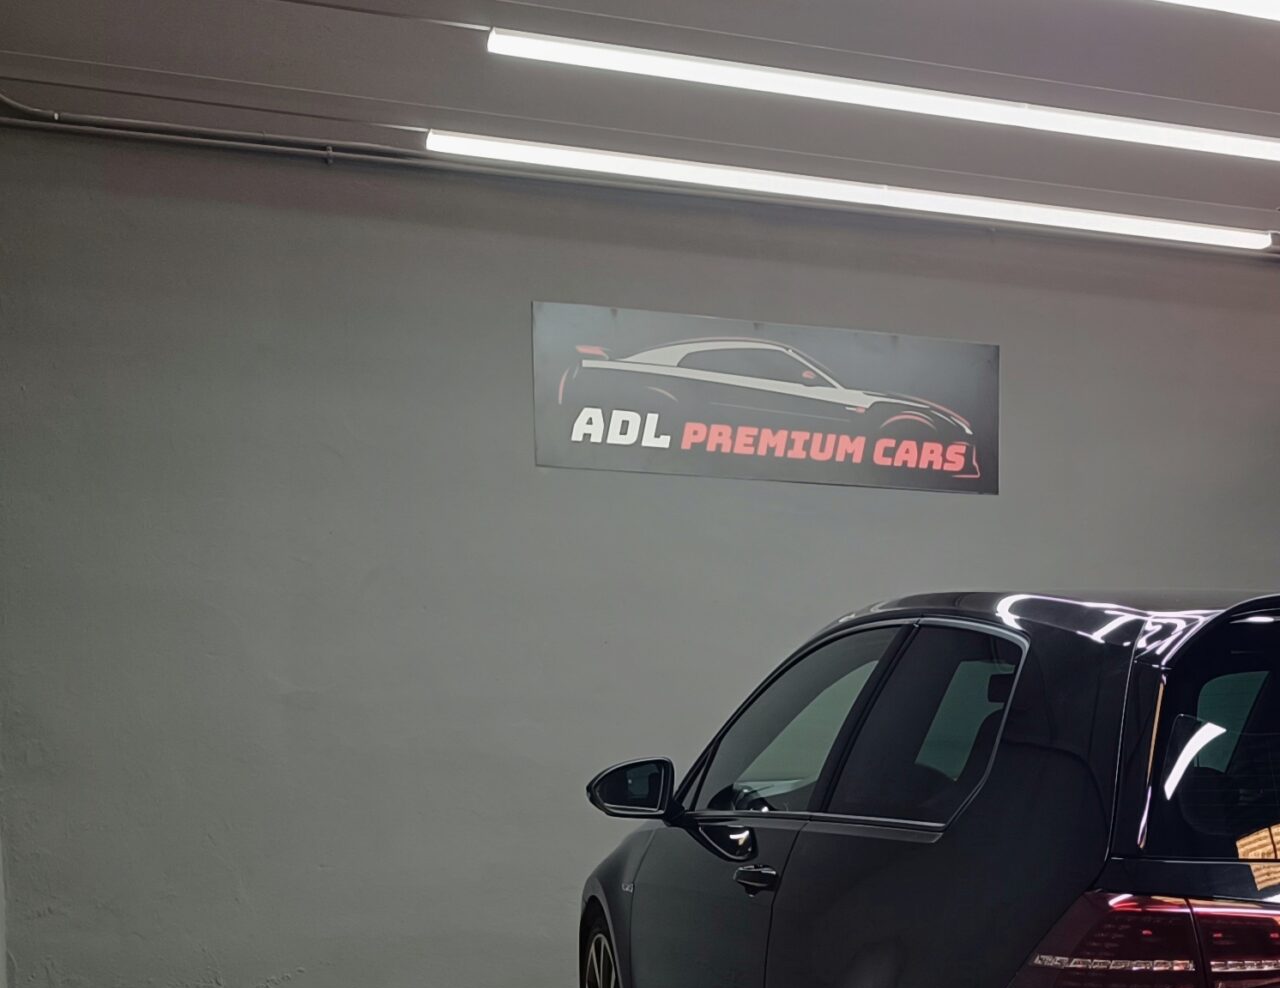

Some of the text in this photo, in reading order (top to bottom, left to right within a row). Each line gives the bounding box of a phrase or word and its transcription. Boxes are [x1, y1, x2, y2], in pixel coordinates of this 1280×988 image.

[571, 407, 967, 472] ADL PREMIUM CARS
